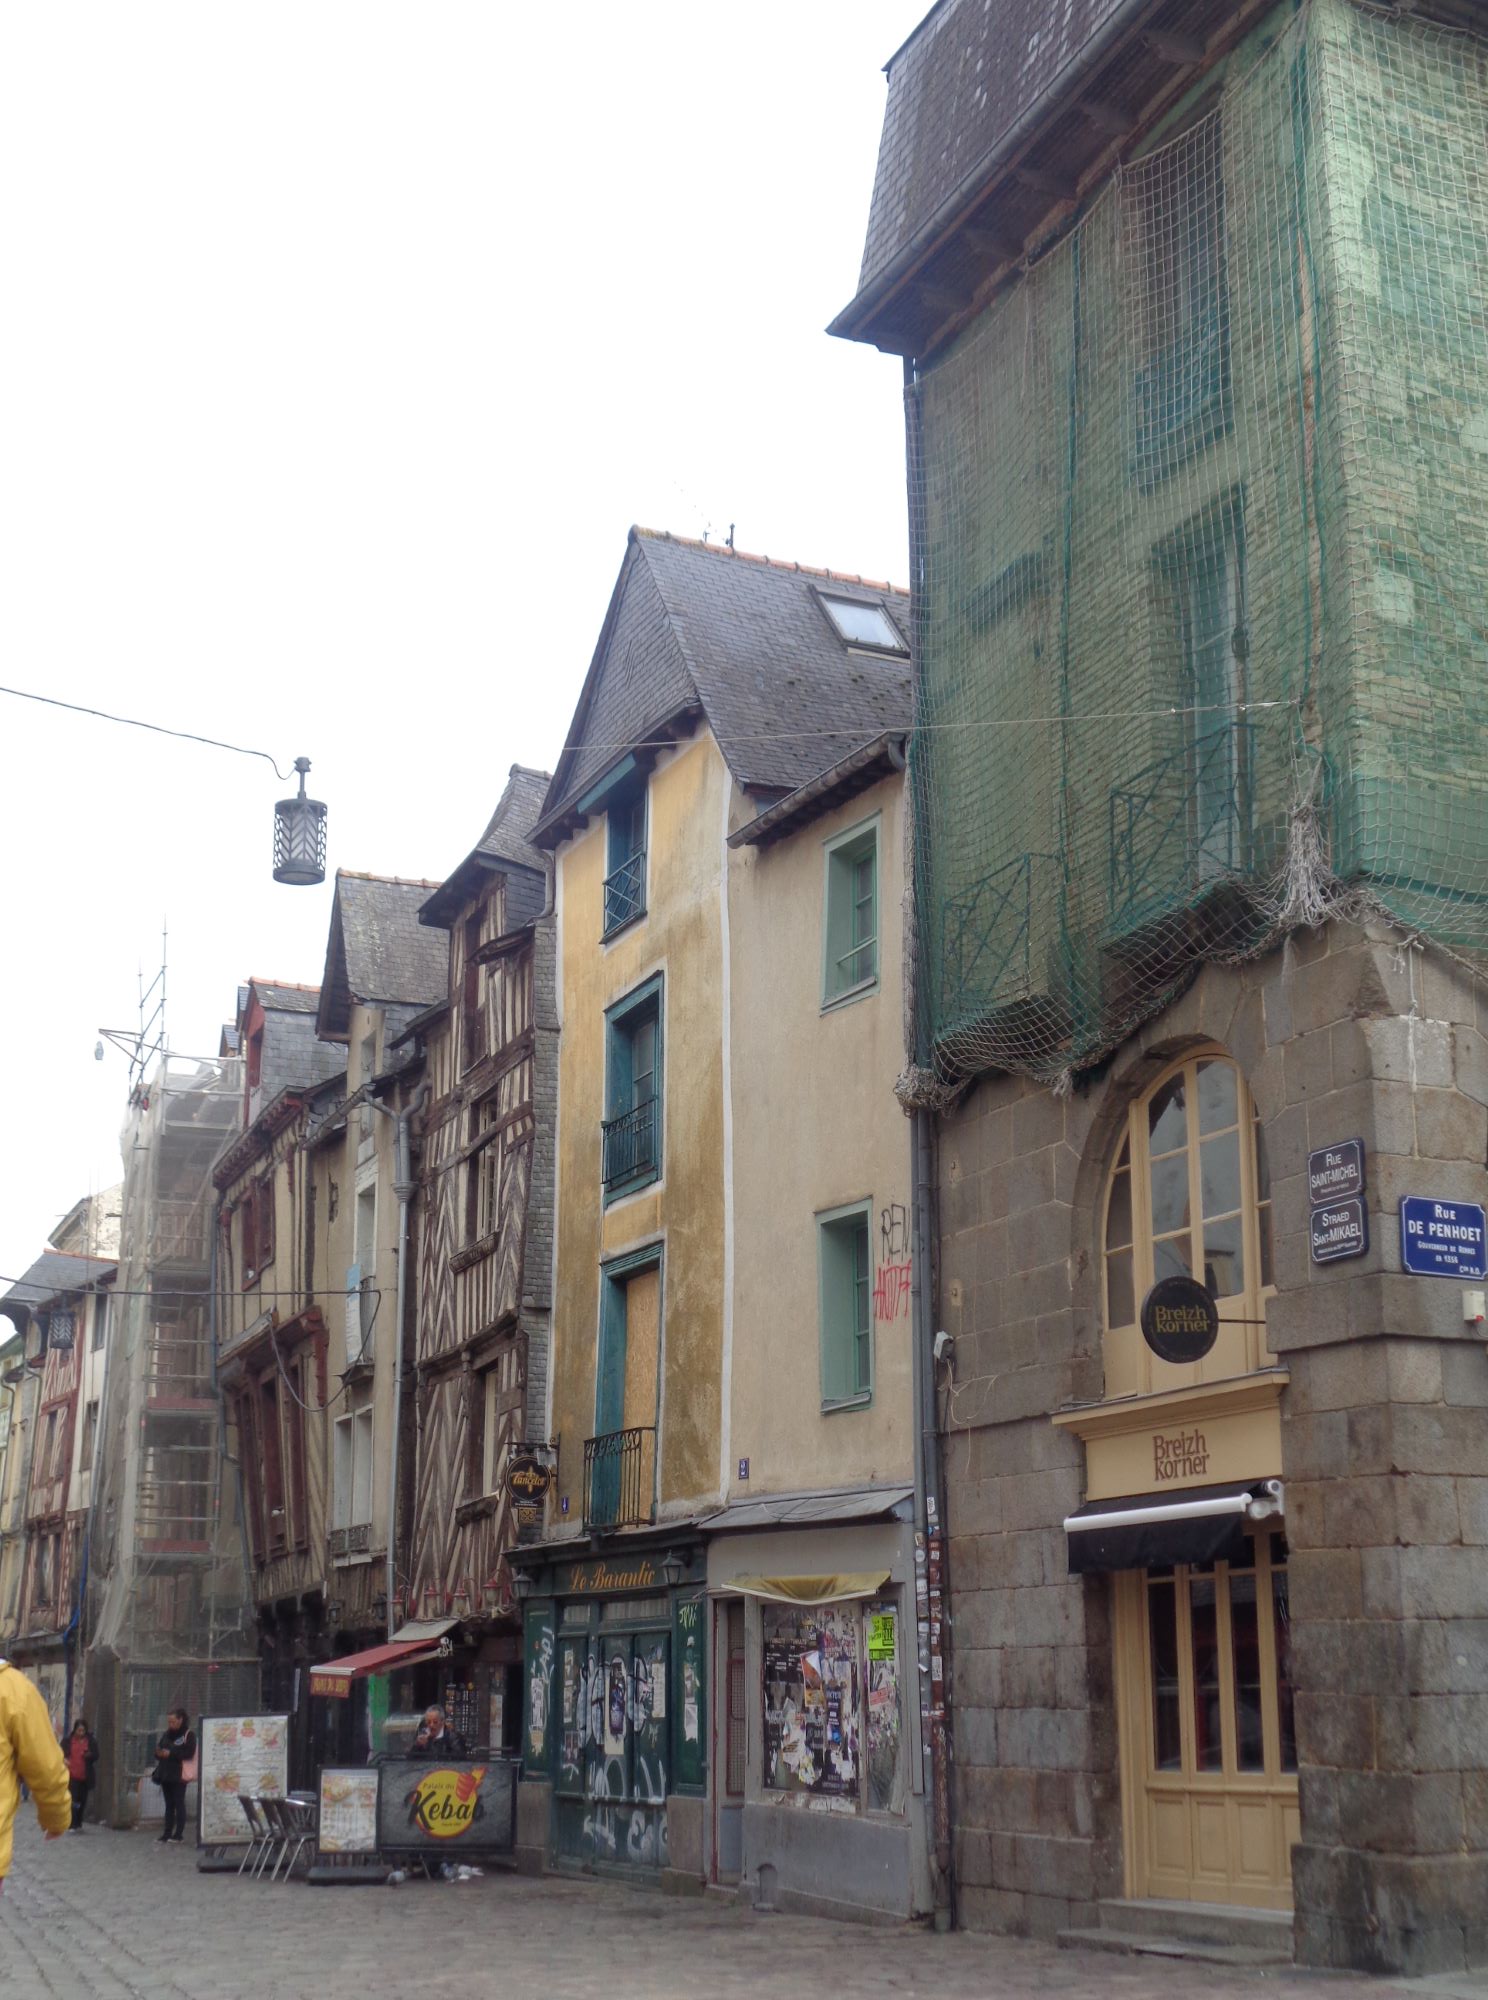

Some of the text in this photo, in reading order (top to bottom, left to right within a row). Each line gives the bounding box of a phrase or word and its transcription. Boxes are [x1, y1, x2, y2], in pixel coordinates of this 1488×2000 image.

[1311, 1163, 1358, 1188] SAINT-MICHEL
[1322, 1211, 1350, 1227] STRAED
[1408, 1220, 1481, 1242] DE PENHOET
[1313, 1222, 1361, 1246] SANT-MIKAEL
[1155, 1304, 1208, 1321] Breizh
[1156, 1318, 1211, 1333] korner
[1152, 1429, 1207, 1460] Breizh
[1154, 1453, 1210, 1481] korner
[404, 1790, 484, 1830] Kebab
